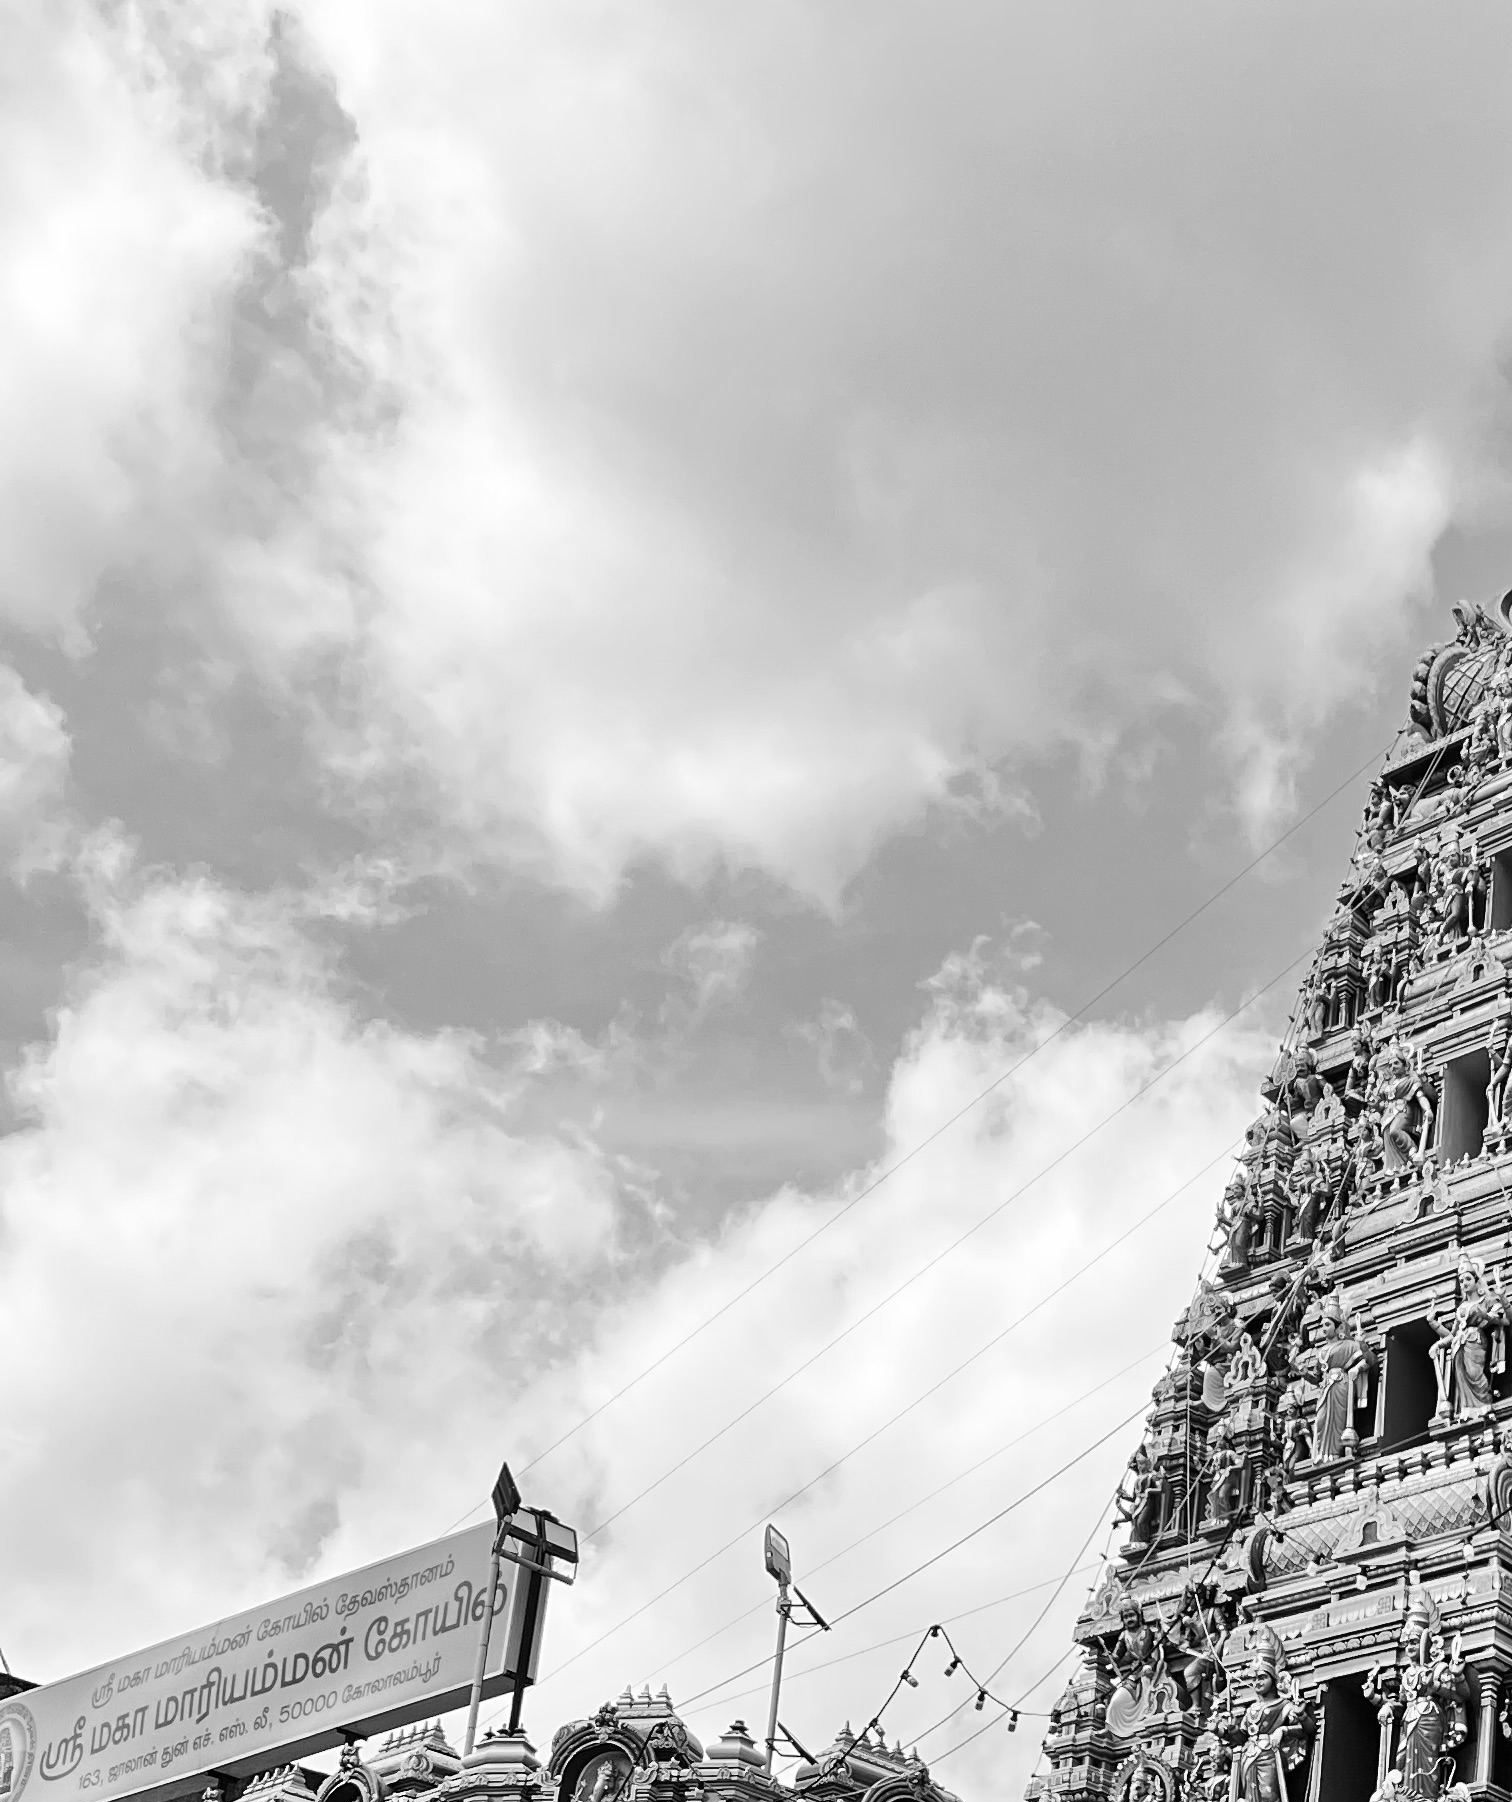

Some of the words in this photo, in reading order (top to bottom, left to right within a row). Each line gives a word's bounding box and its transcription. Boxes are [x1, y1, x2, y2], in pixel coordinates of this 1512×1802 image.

[90, 1705, 149, 1755] மகா
[155, 1626, 354, 1725] மாரியம்மன்
[364, 1570, 508, 1662] கோயில்
[117, 1666, 152, 1693] மகா
[154, 1624, 253, 1676] மாரியம்மன்
[256, 1597, 330, 1642] கோயில்
[79, 1769, 104, 1790] 163,
[279, 1690, 338, 1723] 50000
